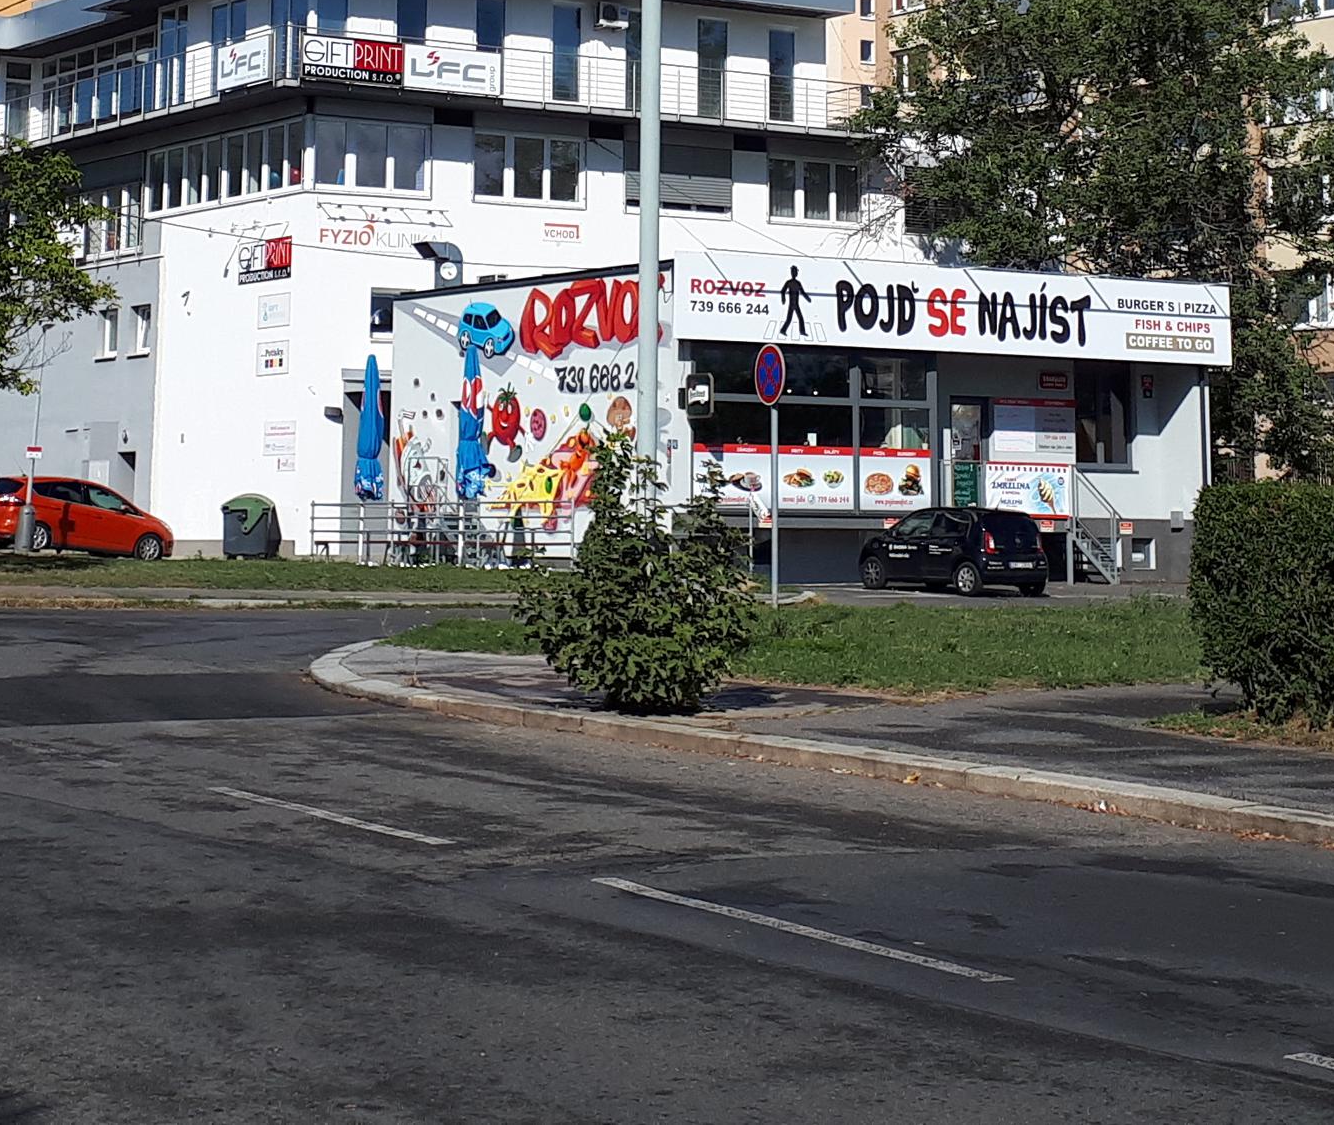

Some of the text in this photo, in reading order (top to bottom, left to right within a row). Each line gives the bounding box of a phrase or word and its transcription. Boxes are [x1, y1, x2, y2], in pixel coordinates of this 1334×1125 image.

[304, 65, 369, 81] PRODUCTION
[319, 228, 371, 246] FYZIO
[544, 229, 575, 239] VCHOD
[690, 278, 766, 297] ROZVOZ
[690, 300, 770, 315] 739 666 244
[927, 288, 967, 337] SE
[978, 282, 1092, 347] NAJÍST
[1184, 303, 1217, 314] PIZZA
[520, 273, 665, 360] ROZVO
[1135, 319, 1211, 333] FISH & CHIPS
[1128, 335, 1212, 350] COFFEE TO GO
[555, 366, 585, 393] 739
[589, 363, 621, 393] 666
